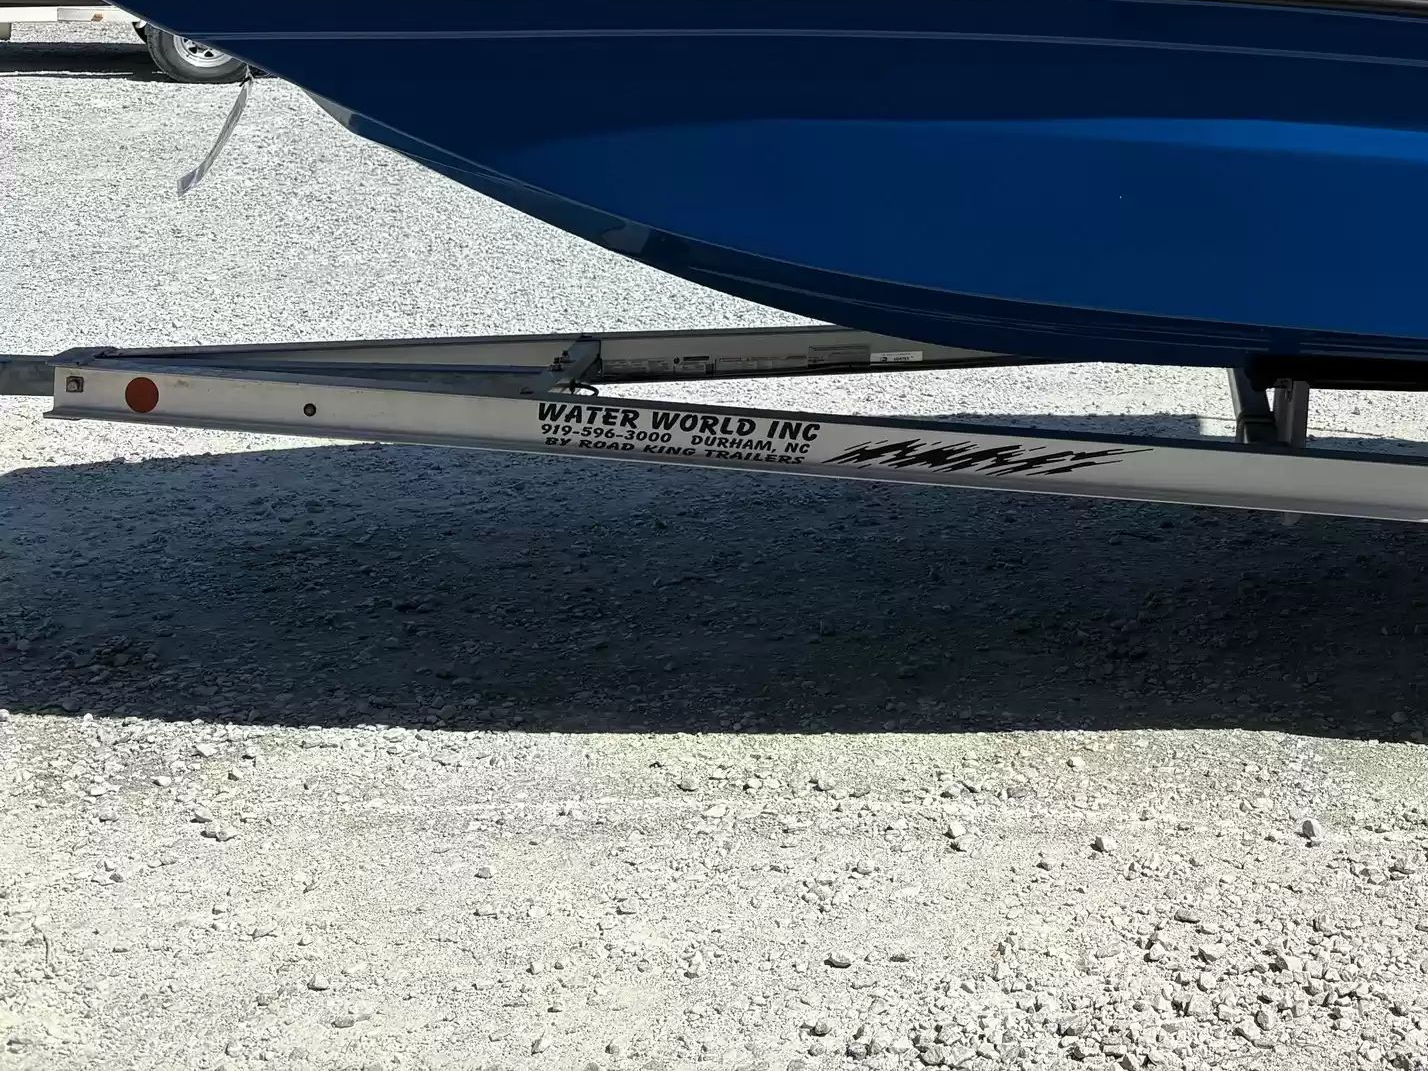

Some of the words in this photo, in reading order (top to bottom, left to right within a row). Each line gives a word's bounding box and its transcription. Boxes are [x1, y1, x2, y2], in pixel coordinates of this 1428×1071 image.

[538, 402, 640, 429] WATER
[652, 411, 756, 437] WORLD
[766, 420, 820, 442] INC
[541, 423, 672, 443] 919-596-3000
[690, 435, 776, 453] DURHAM,
[784, 442, 810, 454] NC
[544, 437, 571, 446] BY
[578, 439, 635, 451] ROAD
[643, 444, 696, 456] KING
[704, 449, 805, 464] TRAILERS
